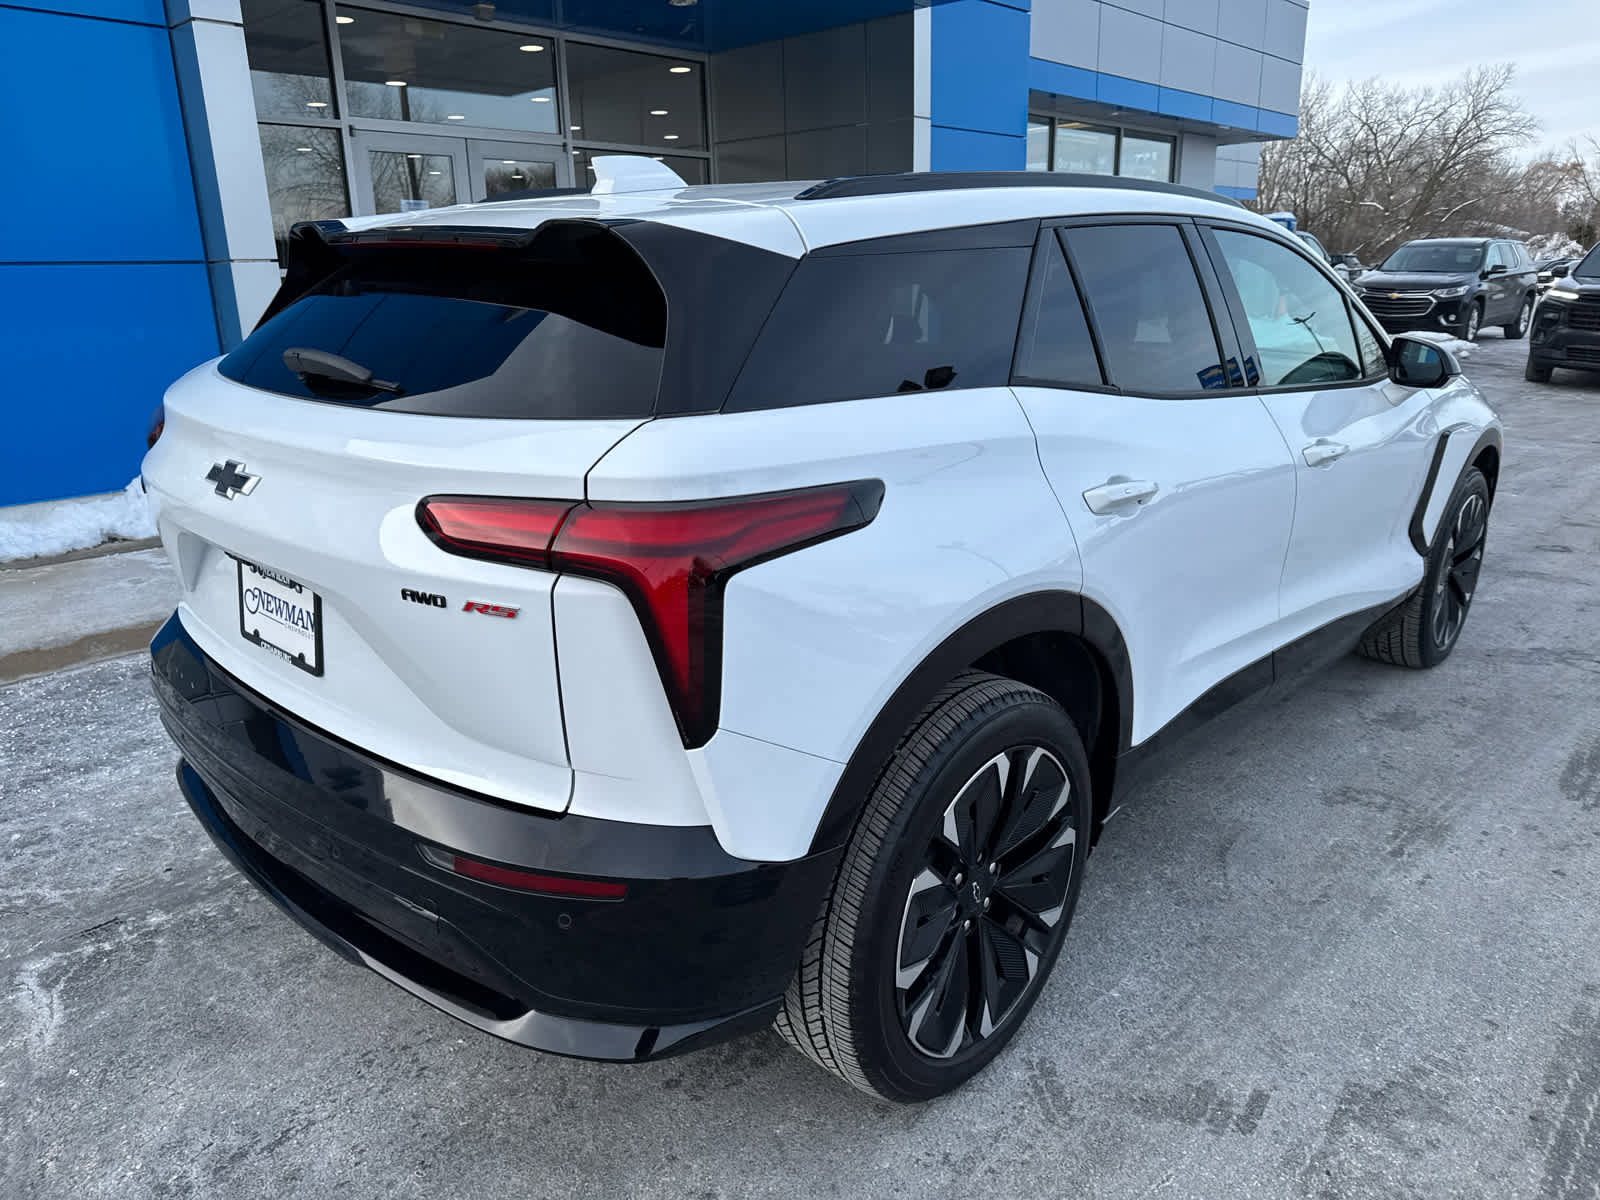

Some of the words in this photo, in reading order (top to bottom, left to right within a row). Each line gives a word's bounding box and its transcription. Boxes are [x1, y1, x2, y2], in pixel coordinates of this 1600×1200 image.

[400, 587, 447, 608] AWD
[244, 587, 315, 633] NEWMAN
[462, 600, 520, 619] RS
